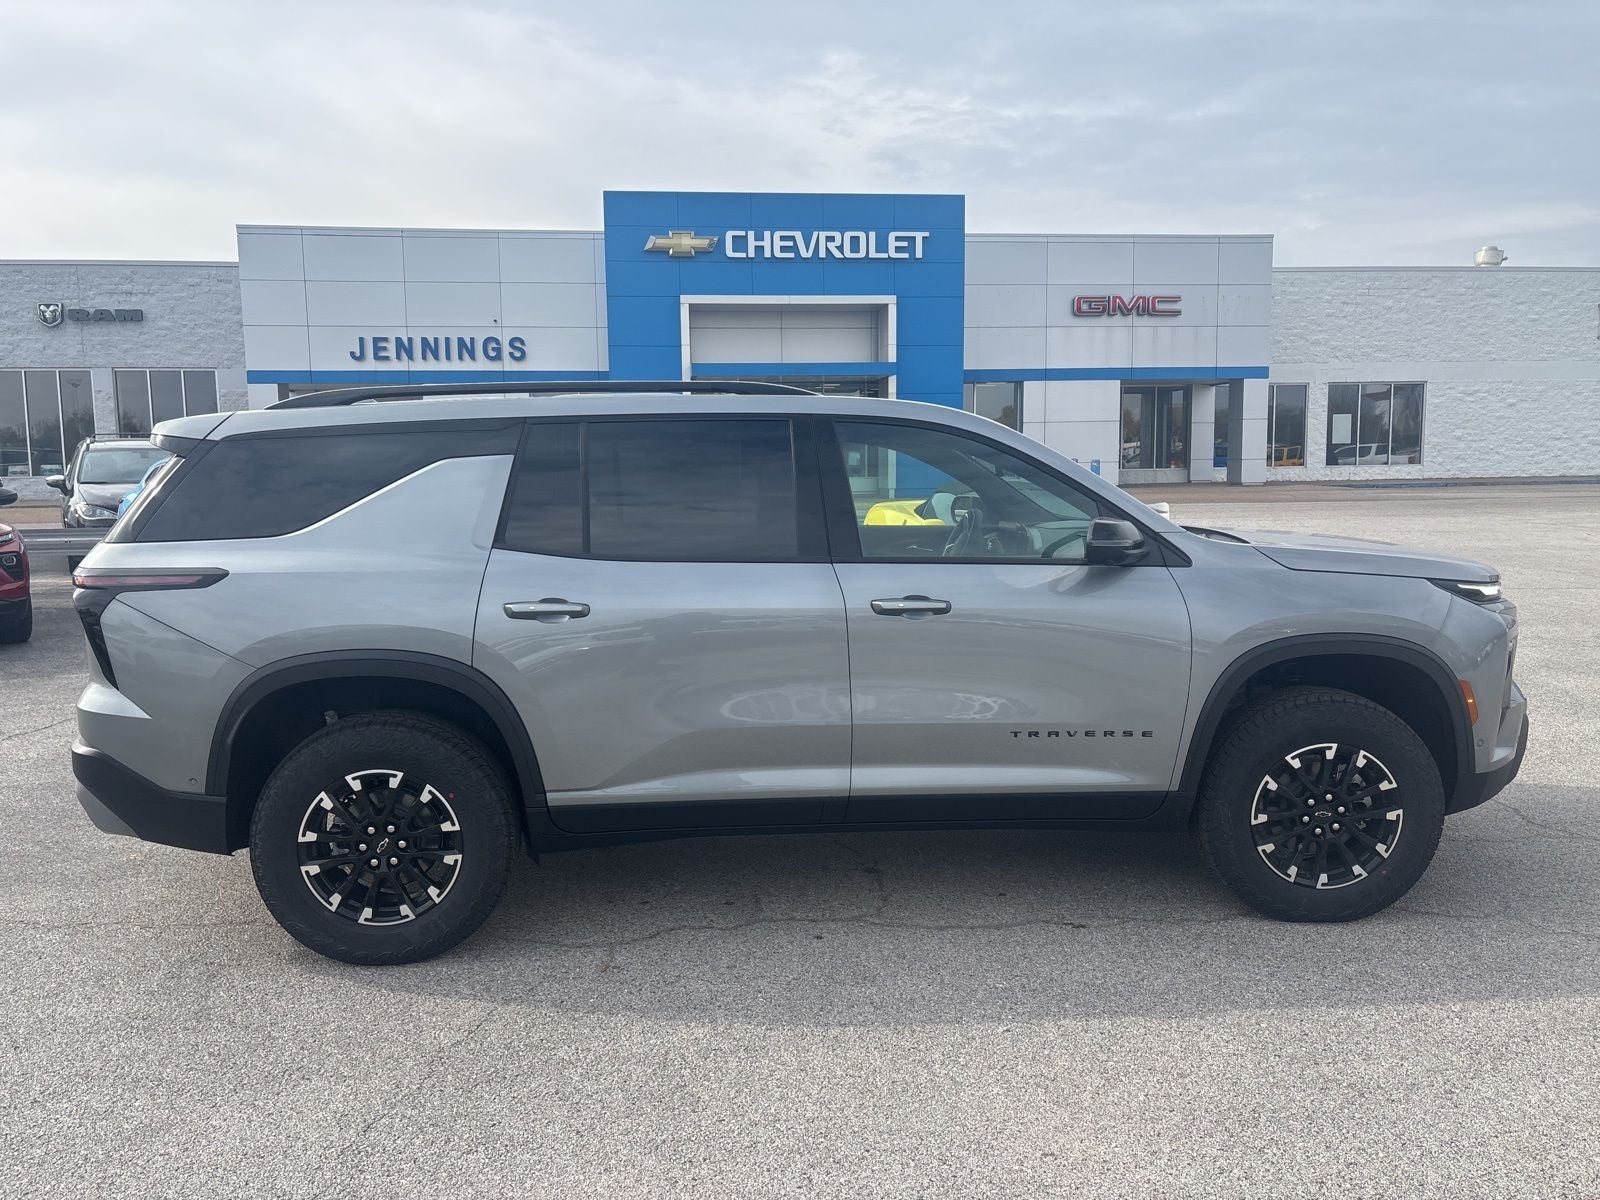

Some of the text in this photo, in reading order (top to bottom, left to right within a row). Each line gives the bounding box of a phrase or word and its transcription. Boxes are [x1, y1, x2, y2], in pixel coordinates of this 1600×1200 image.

[725, 230, 929, 259] CHEVROLET
[67, 308, 144, 321] RAM
[1073, 295, 1182, 316] GMC
[349, 336, 527, 361] JENNINGS
[1010, 730, 1154, 738] TRAVERSE
